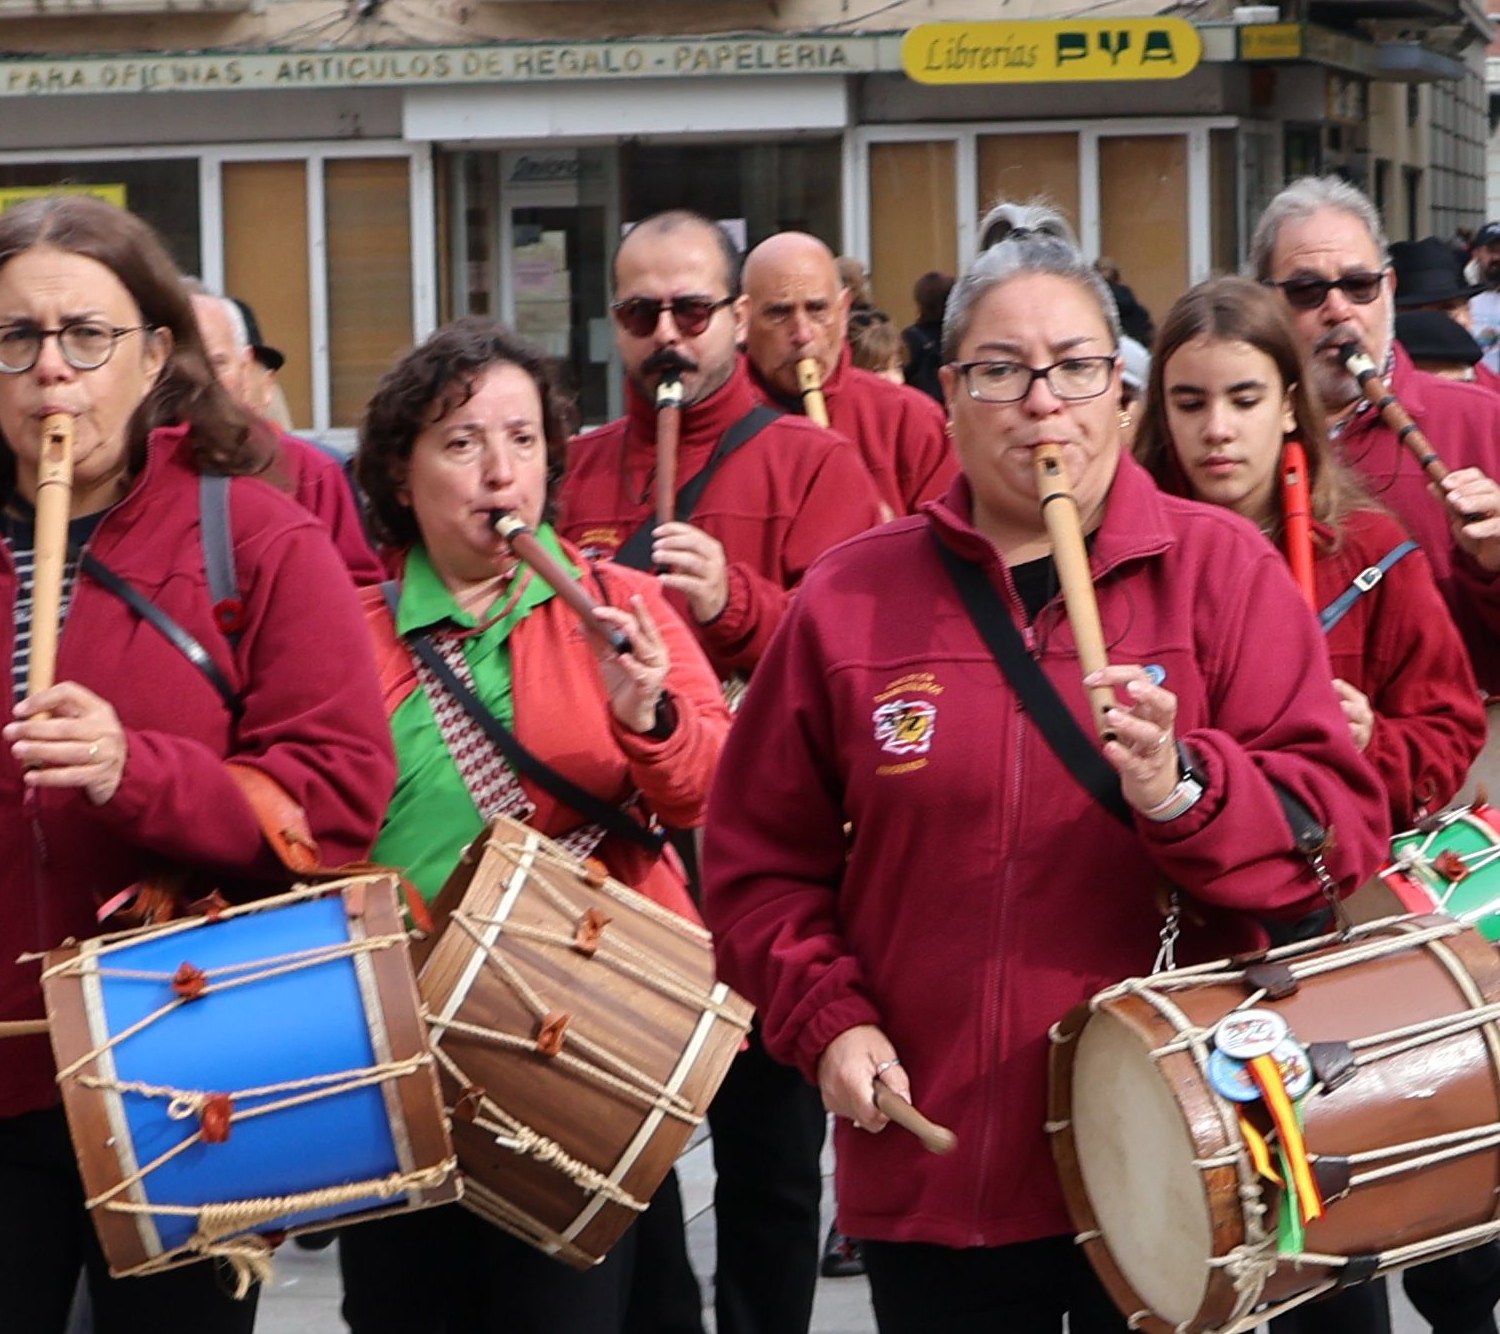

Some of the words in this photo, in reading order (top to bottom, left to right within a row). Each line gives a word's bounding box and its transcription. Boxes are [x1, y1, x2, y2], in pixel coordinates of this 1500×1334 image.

[8, 66, 86, 94] PARA
[274, 53, 451, 84] ARTICULOS
[462, 49, 506, 77] DE
[514, 46, 645, 76] REGALO
[674, 42, 849, 73] PAPELERIA
[1055, 29, 1178, 67] PYA
